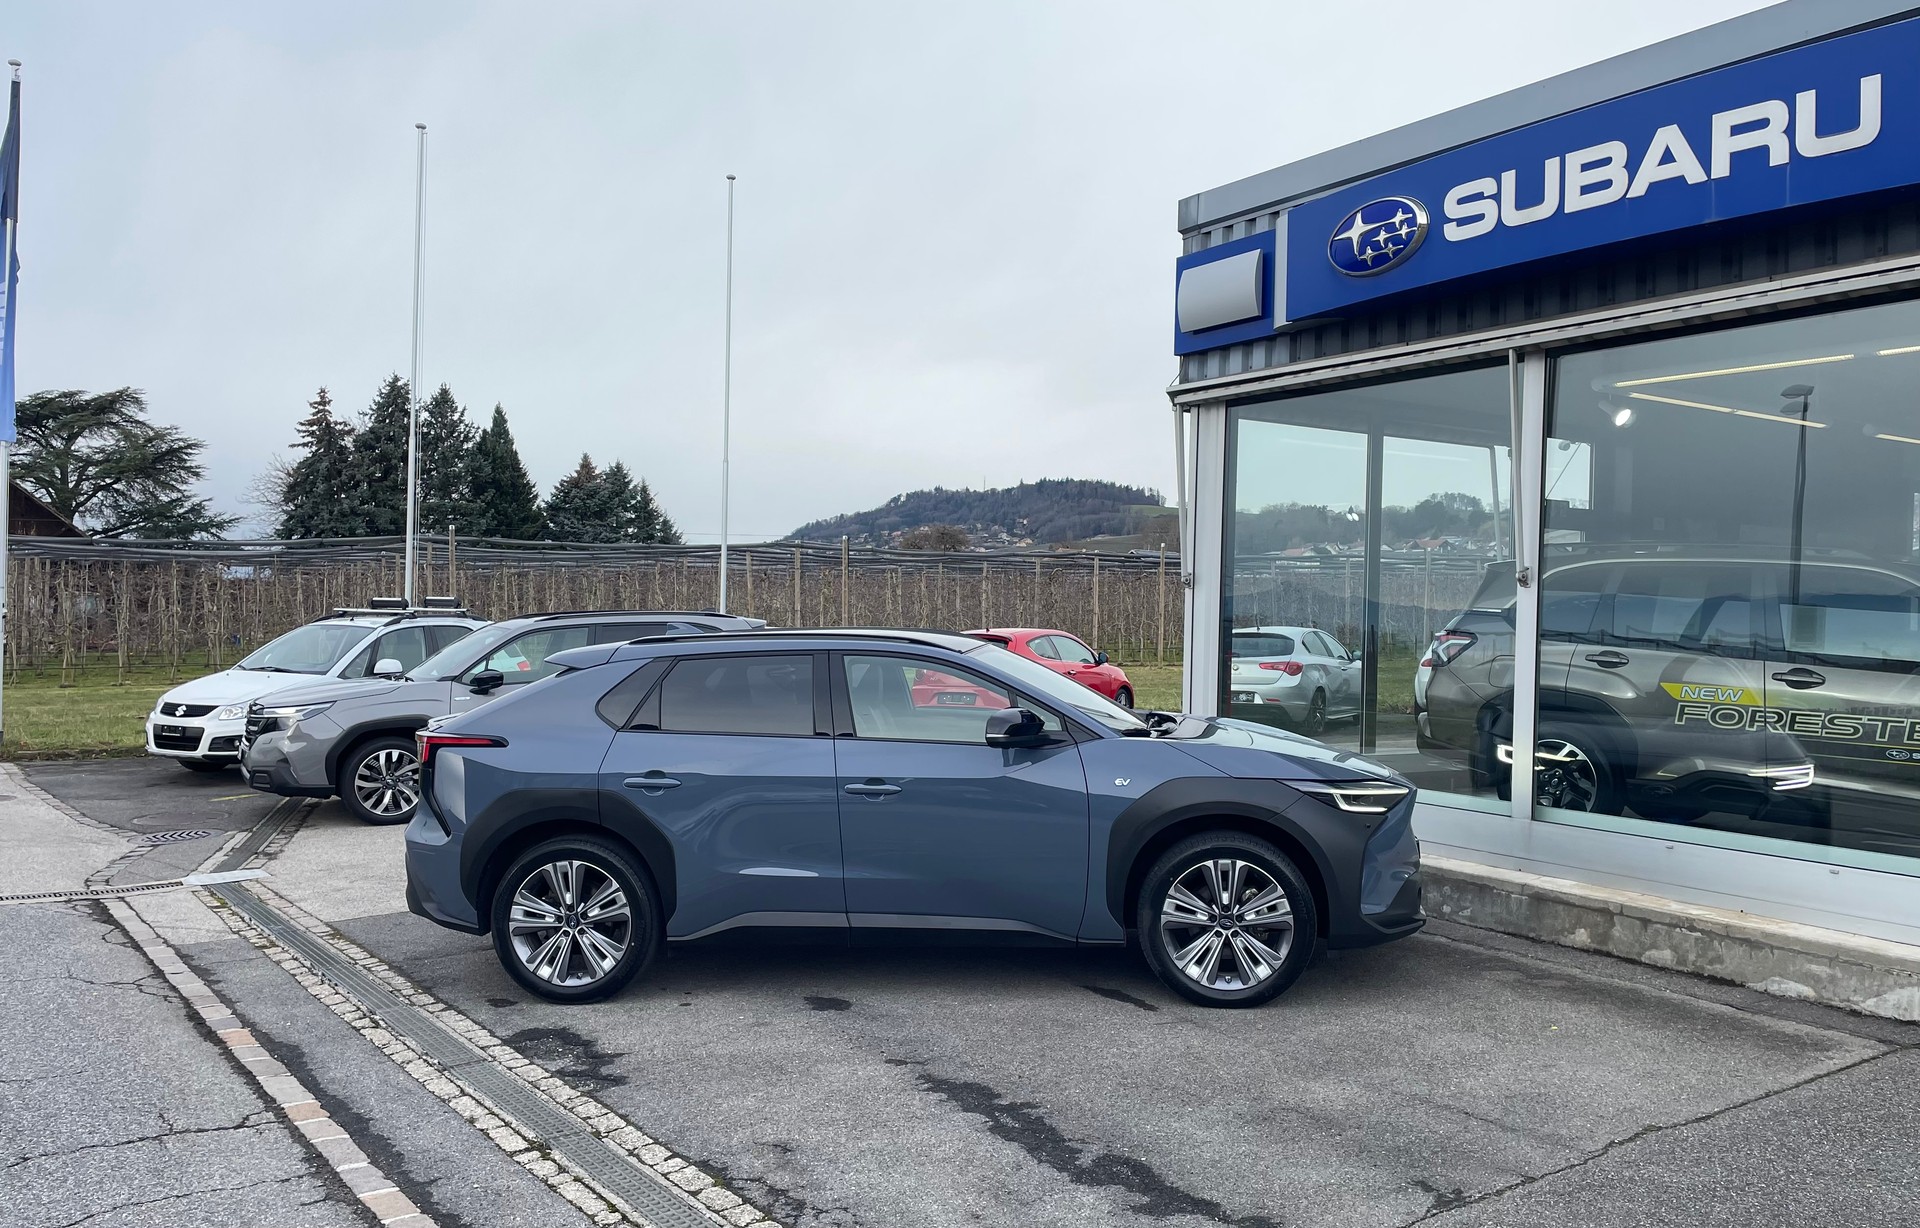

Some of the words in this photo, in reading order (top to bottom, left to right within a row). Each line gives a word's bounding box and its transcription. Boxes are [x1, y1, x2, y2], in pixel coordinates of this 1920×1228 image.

[1443, 73, 1882, 242] SUBARU
[1681, 686, 1743, 702] NEW
[1114, 778, 1131, 786] EV
